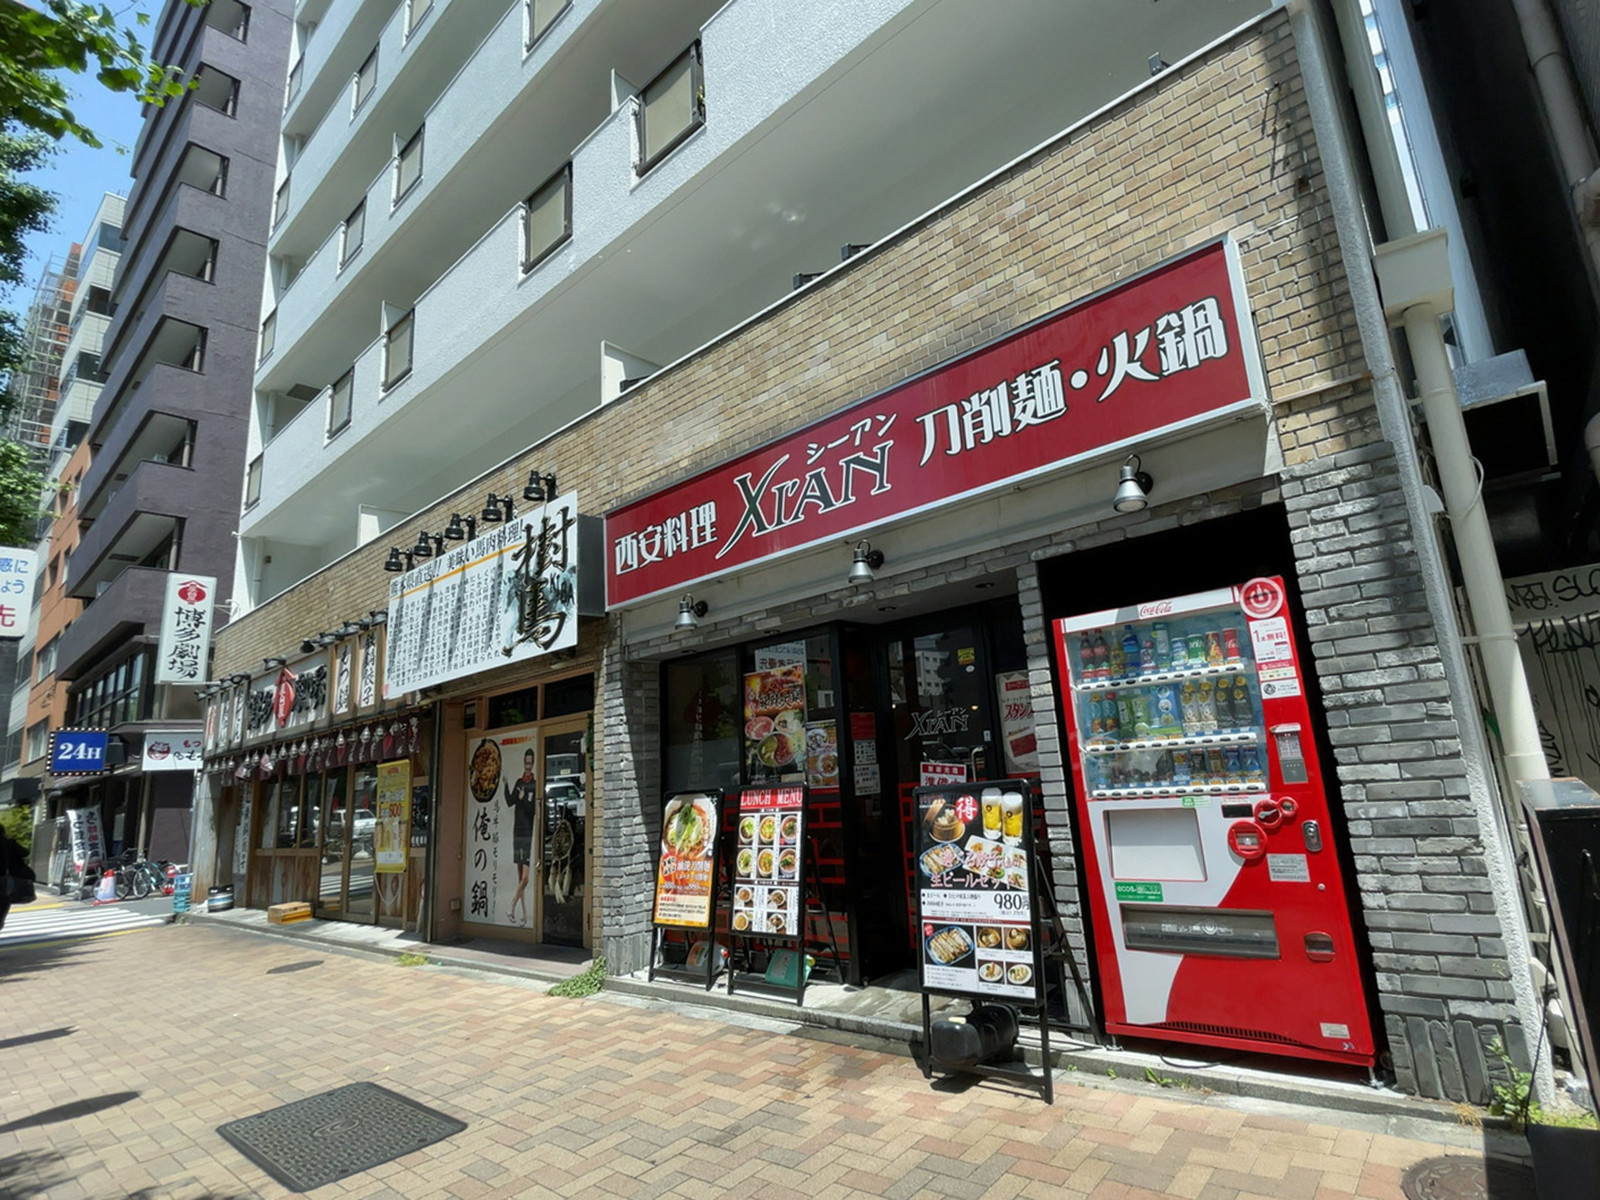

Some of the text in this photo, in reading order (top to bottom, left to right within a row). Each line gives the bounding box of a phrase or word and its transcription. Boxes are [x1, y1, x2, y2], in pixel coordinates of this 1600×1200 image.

[914, 295, 1229, 467] 刀削麺・火鍋
[806, 411, 898, 466] シーアン
[614, 500, 718, 576] 西安料理
[1139, 601, 1173, 620] Coca-Cola
[167, 606, 206, 681] 博多劇場
[937, 706, 967, 717] シーアン
[58, 742, 102, 760] 24H
[740, 787, 803, 806] LUNCH MENU
[955, 795, 978, 822] 得
[471, 807, 492, 919] 俺の鍋
[930, 872, 1013, 890] 生ビールセット
[994, 893, 1022, 911] 980
